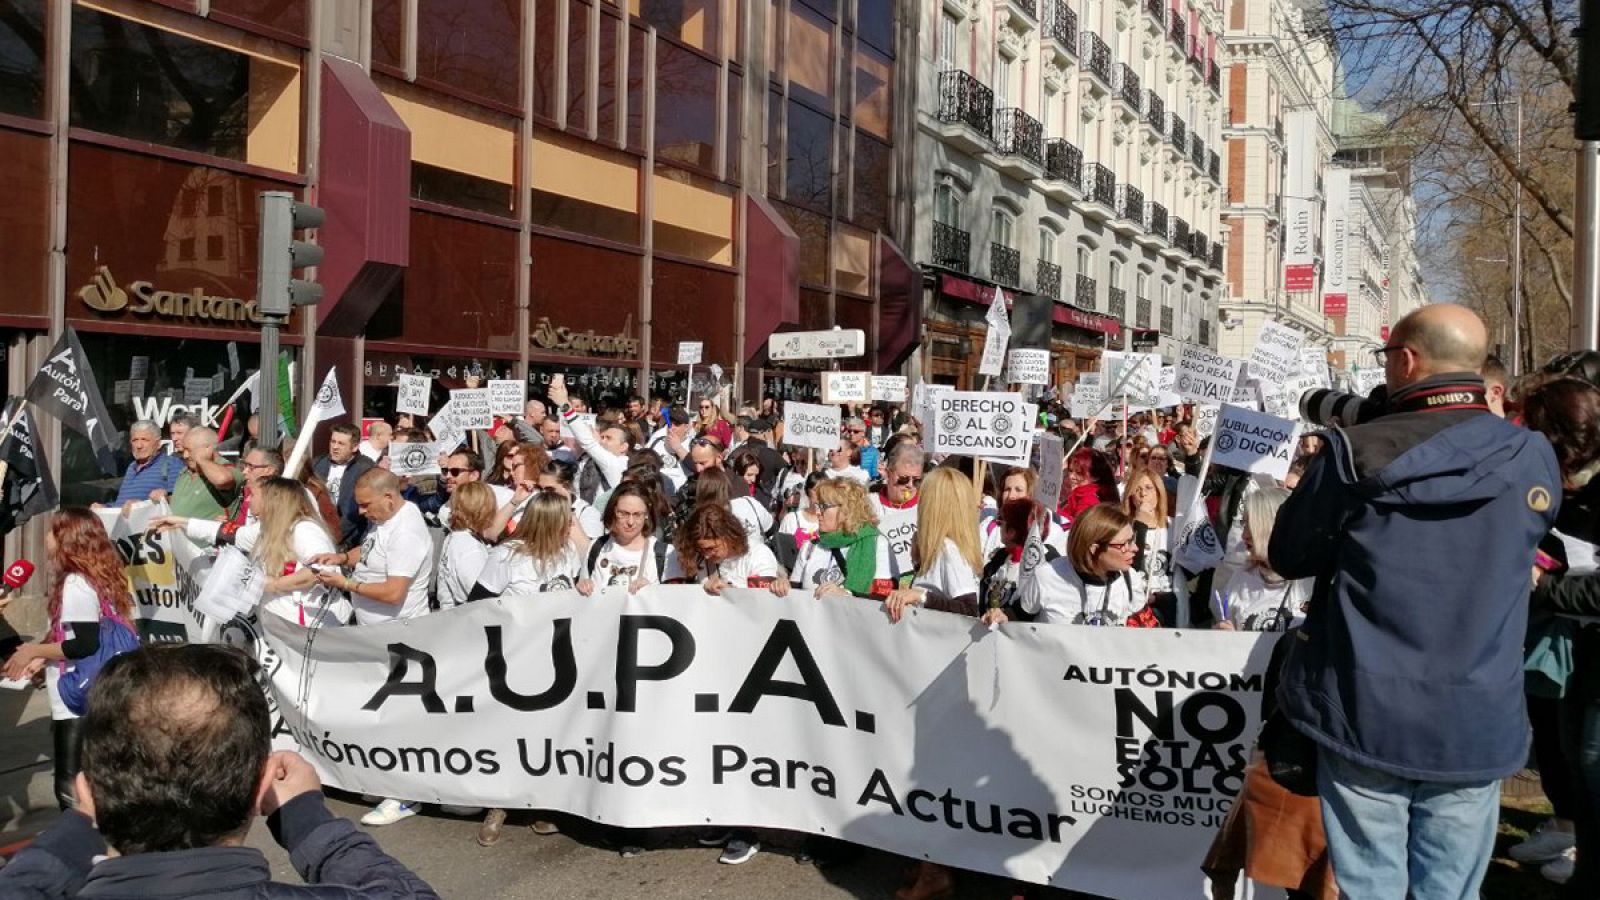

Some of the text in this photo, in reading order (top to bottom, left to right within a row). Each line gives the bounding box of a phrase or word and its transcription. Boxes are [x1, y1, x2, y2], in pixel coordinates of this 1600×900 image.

[1294, 210, 1309, 255] Rodin
[1181, 359, 1233, 380] PARO REAL
[1183, 349, 1233, 368] DERECHO A
[942, 399, 1014, 413] DERECHO
[1427, 392, 1474, 405] Canon
[806, 424, 837, 435] DIGNA
[966, 417, 987, 430] AL
[1220, 418, 1292, 444] JUBILACIÓN
[938, 434, 1017, 449] DESCANSO
[1239, 437, 1288, 460] DIGNA
[361, 613, 877, 734] A.U.P.A.
[1114, 688, 1246, 744] NO
[1116, 737, 1246, 771] ESTAS
[271, 715, 1078, 844] Autónomos Unidos Para Actuar
[1117, 763, 1246, 797] SOLO
[1070, 784, 1165, 809] SOMOS
[1071, 800, 1195, 826] LUCHEMOS
